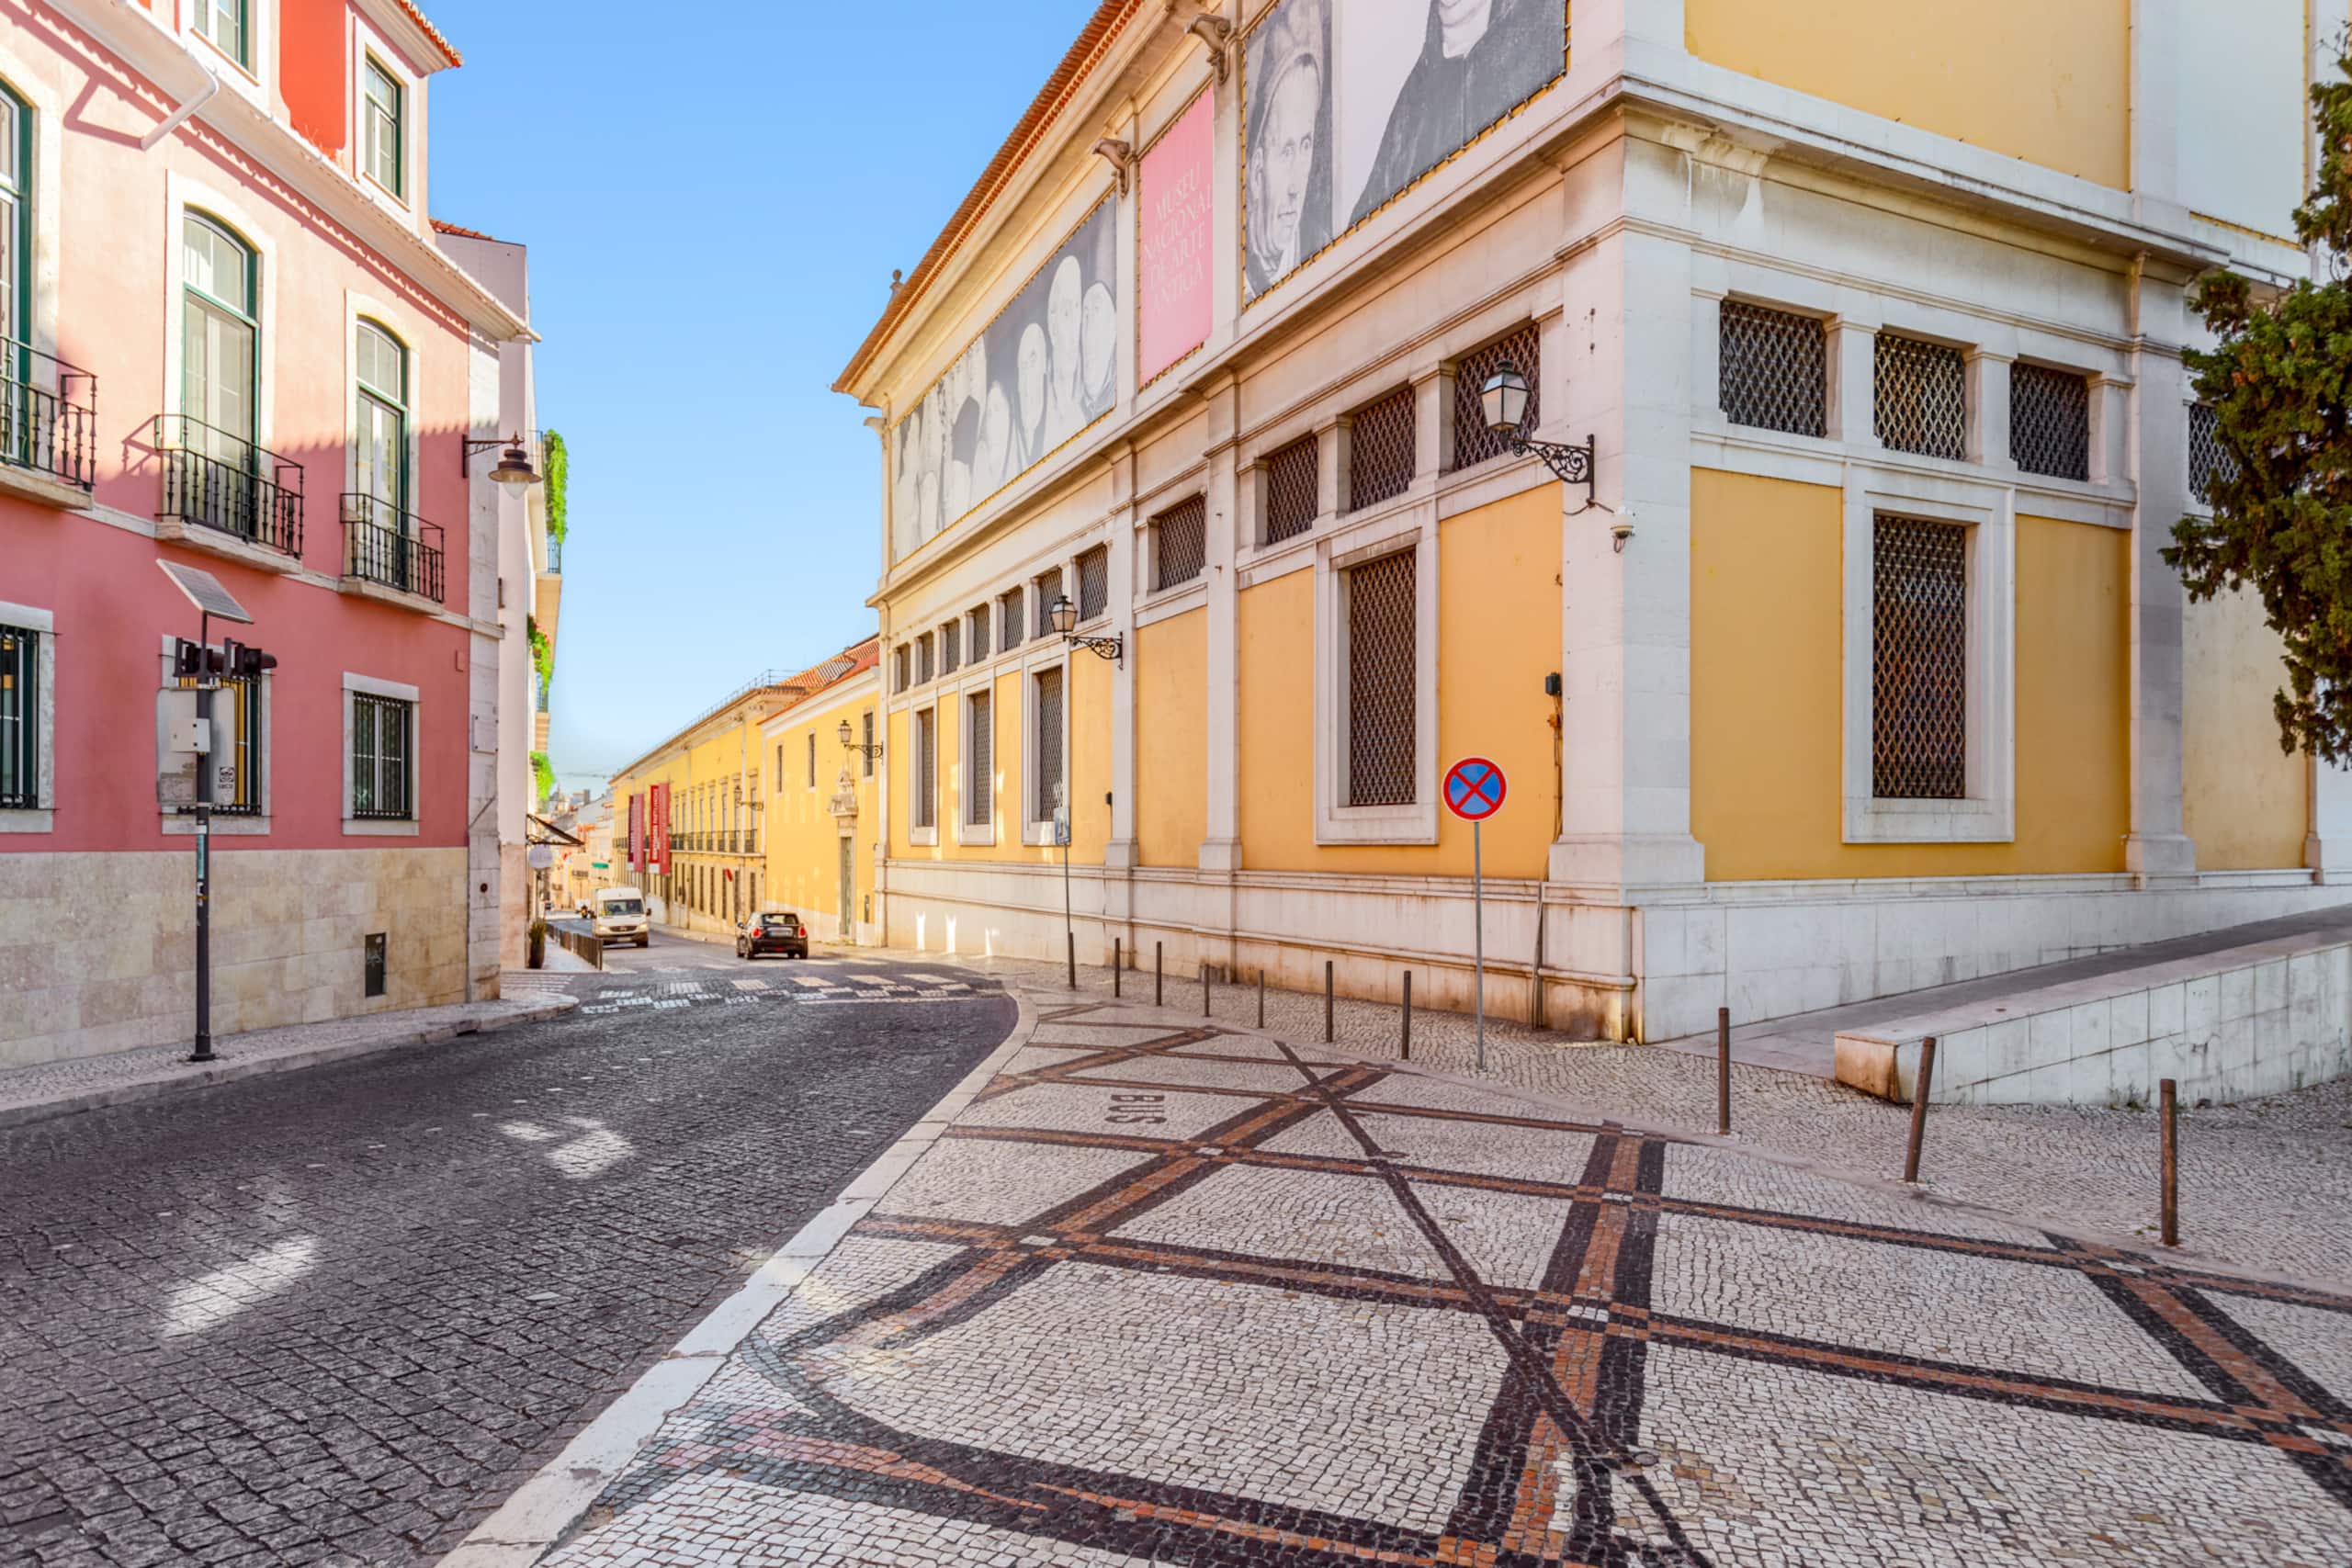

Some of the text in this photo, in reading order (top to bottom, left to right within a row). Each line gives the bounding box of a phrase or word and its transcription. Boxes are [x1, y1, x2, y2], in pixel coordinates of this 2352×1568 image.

[1155, 162, 1200, 221] MUSEU
[1143, 184, 1213, 264] NACIONAL
[1149, 222, 1205, 289] DE ARTE
[1153, 259, 1204, 315] ANTIGA
[1104, 1094, 1167, 1123] BUS
